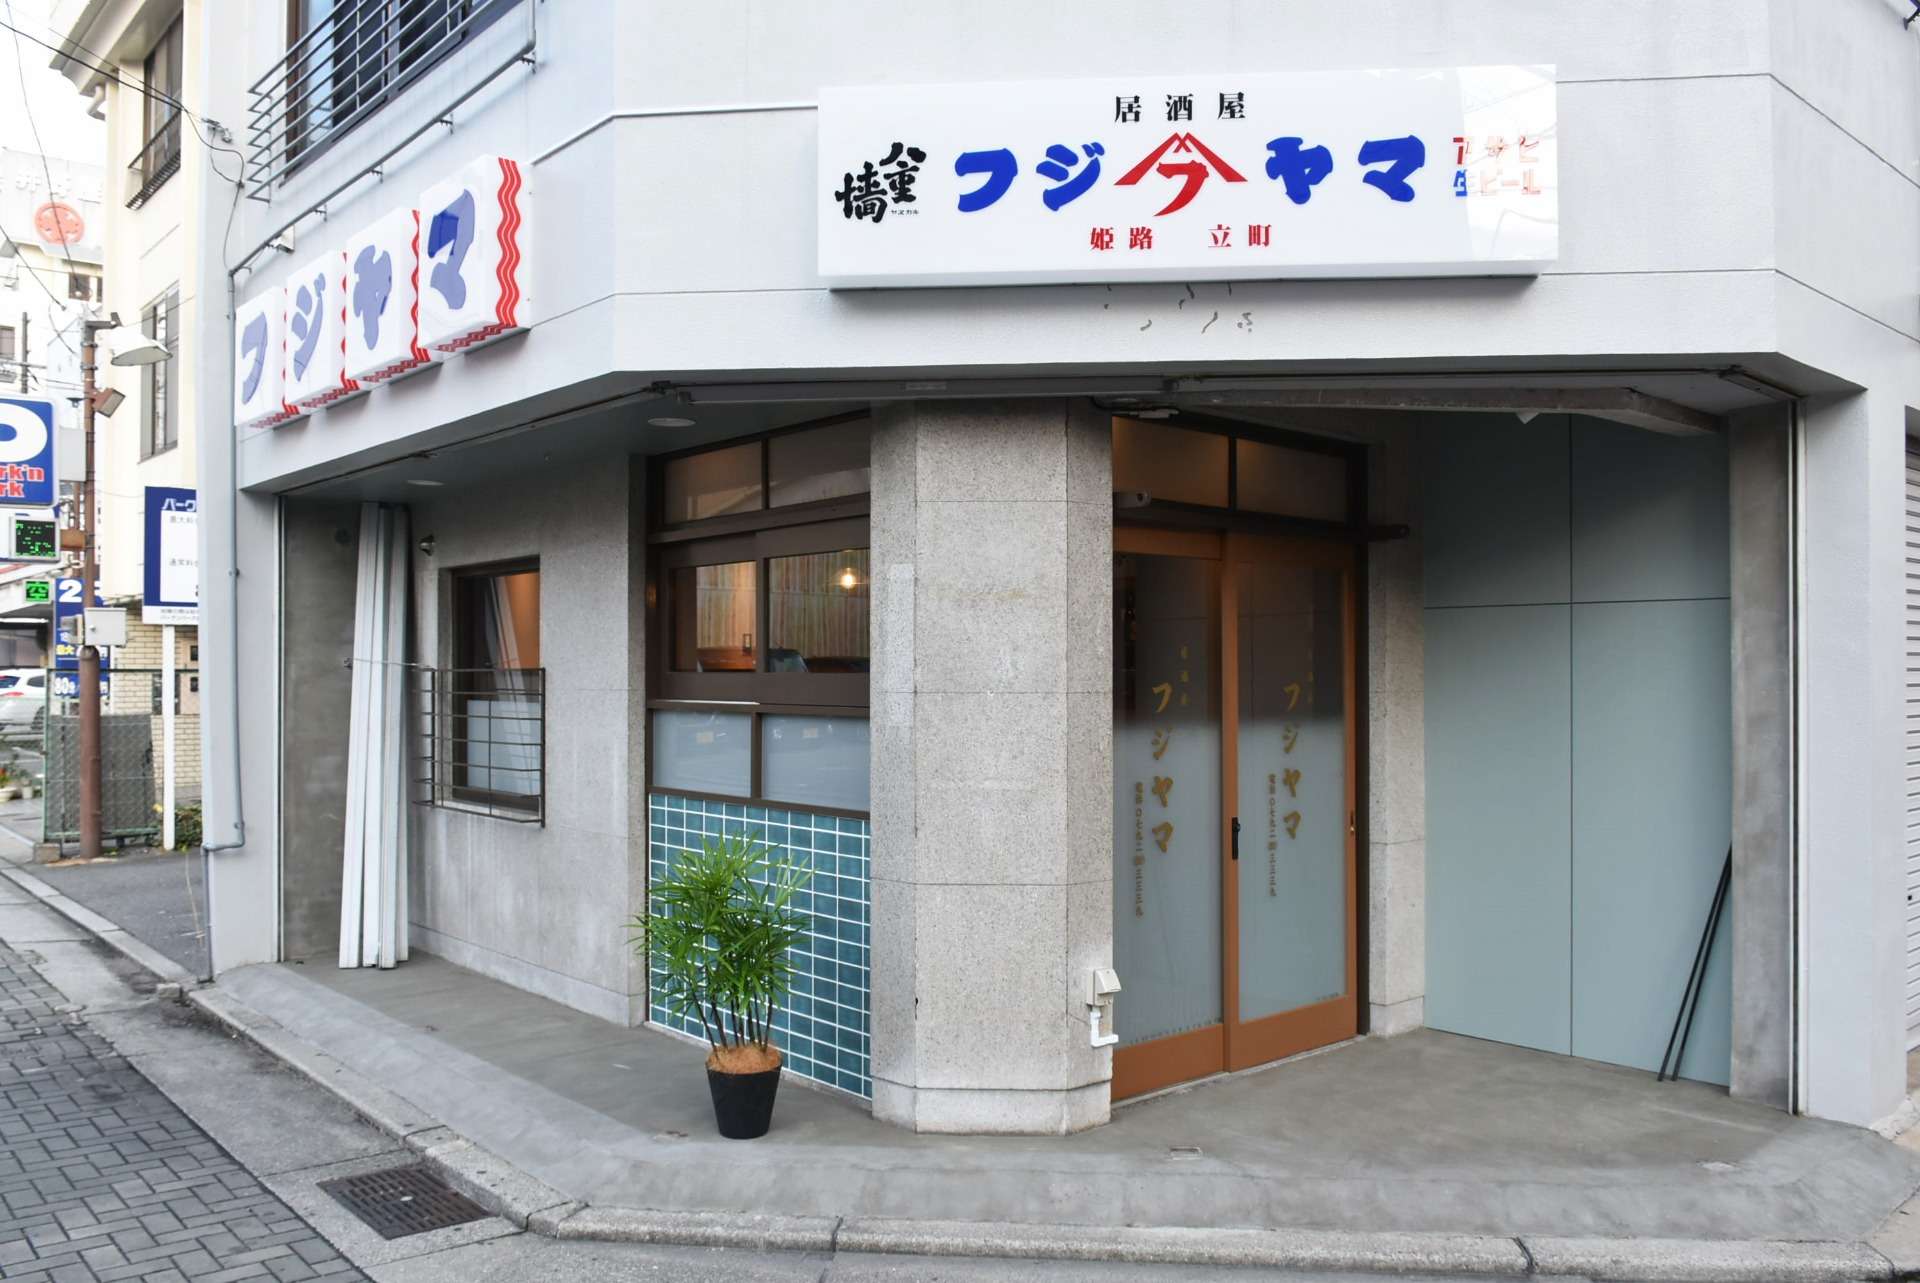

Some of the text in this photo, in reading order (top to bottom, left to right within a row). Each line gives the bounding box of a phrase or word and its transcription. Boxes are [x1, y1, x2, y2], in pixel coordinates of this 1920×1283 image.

[1113, 92, 1248, 124] 居酒屋
[1089, 223, 1272, 251] 姫路 立町
[239, 188, 476, 407] フジヤマ
[26, 580, 49, 602] 空
[1150, 681, 1175, 853] フジヤマ
[1281, 682, 1302, 840] フジヤマ
